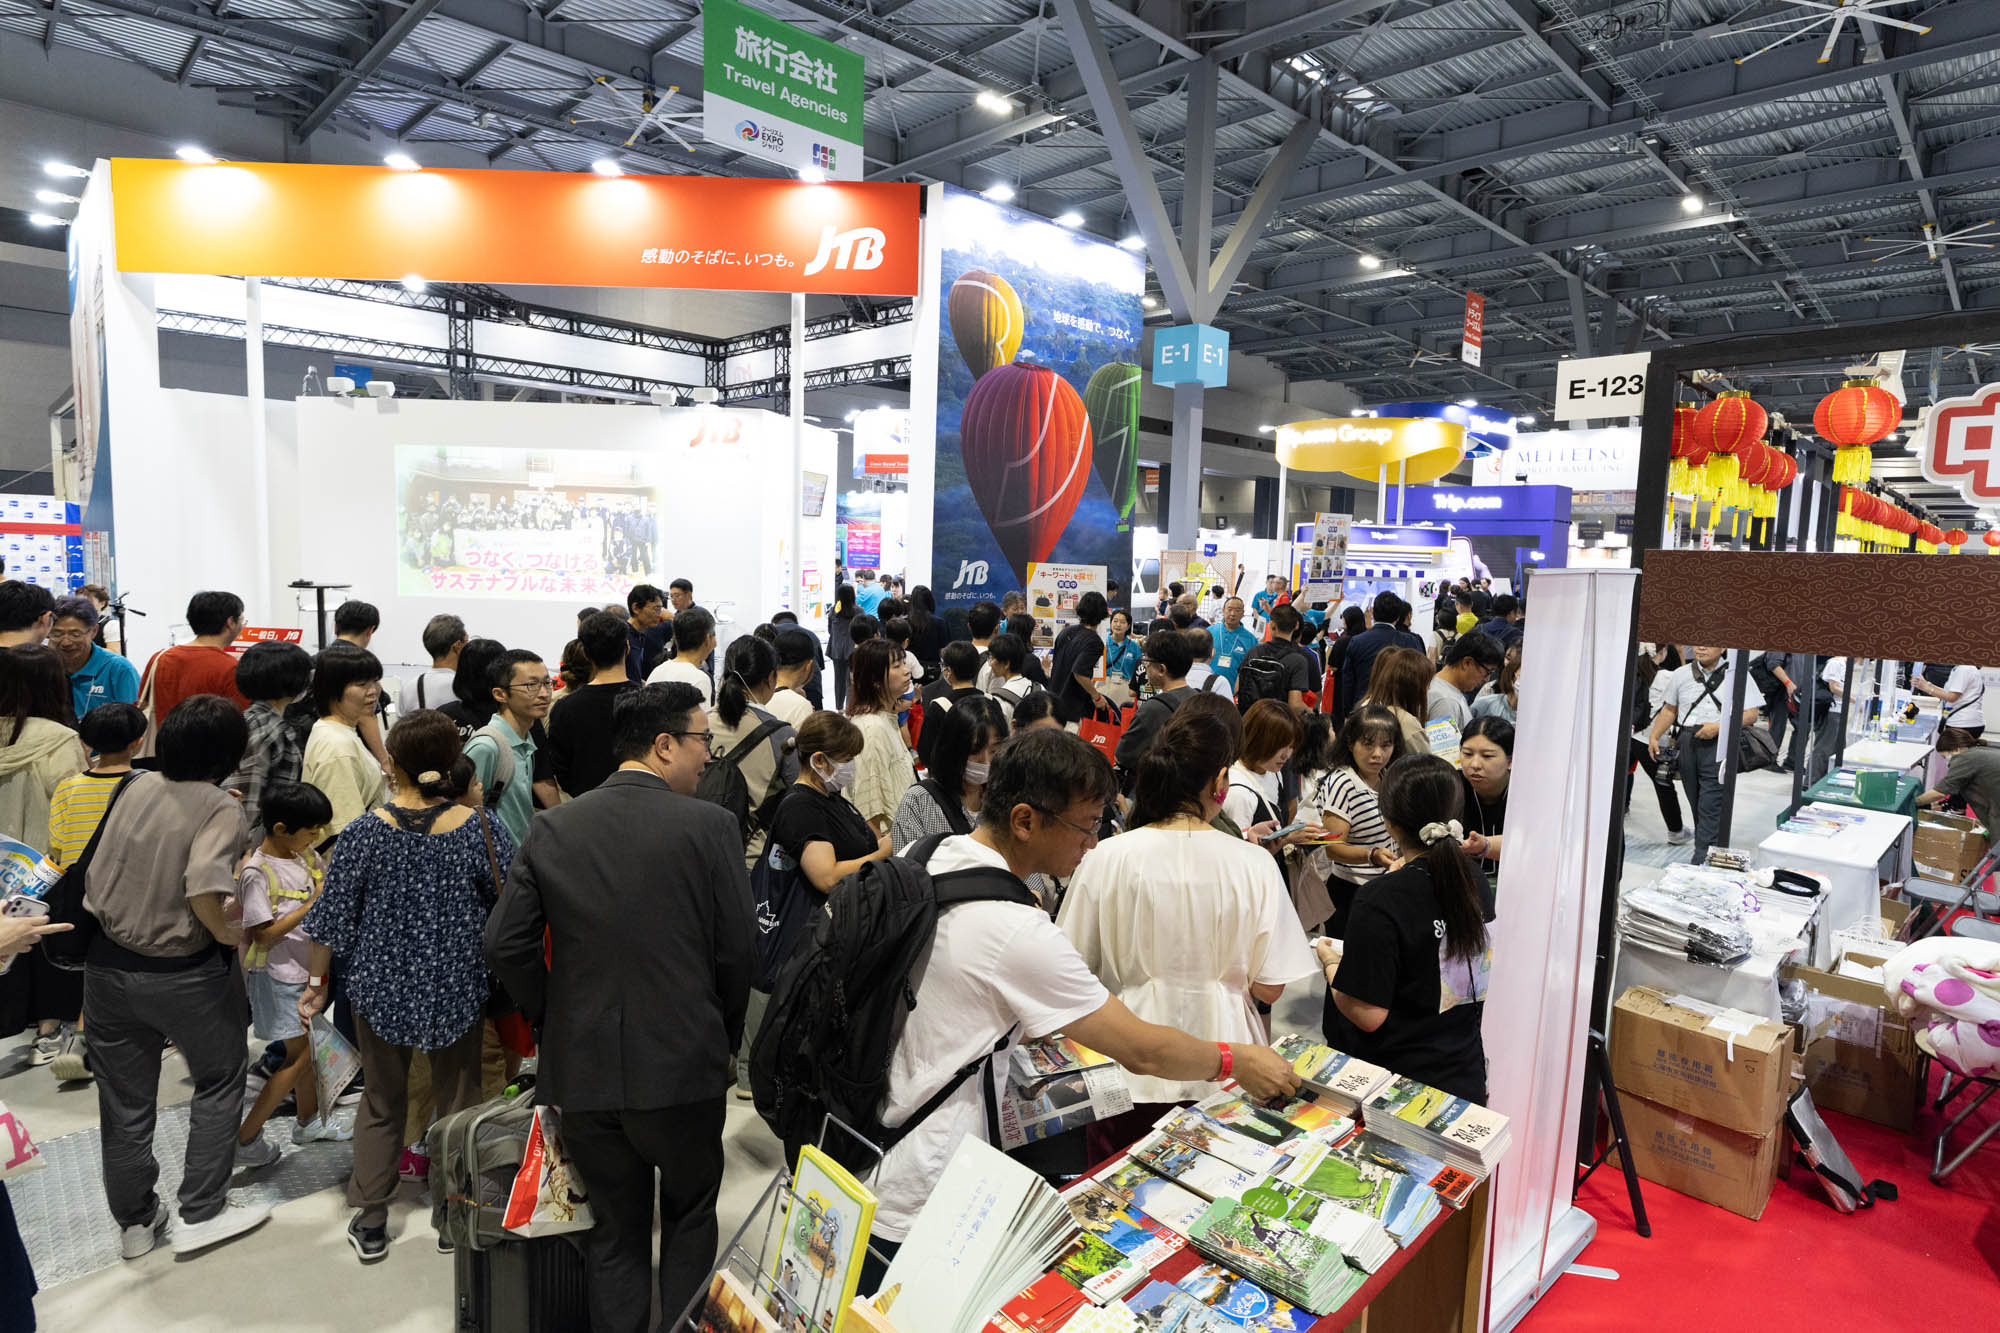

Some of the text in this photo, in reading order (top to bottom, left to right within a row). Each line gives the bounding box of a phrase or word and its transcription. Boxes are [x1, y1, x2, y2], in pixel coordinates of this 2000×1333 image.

[735, 25, 838, 95] 旅行会社
[722, 63, 848, 124] Travel Agencies
[761, 132, 784, 146] EXPO
[762, 142, 784, 153] ジャパン
[640, 247, 795, 268] 感動のそばに、いつも。
[803, 225, 886, 277] JTB
[1053, 310, 1135, 343] 地球を感動で、つなぐ。
[1161, 343, 1190, 365] E-1
[1203, 343, 1223, 367] E-1
[1568, 374, 1644, 400] E-123
[1338, 423, 1392, 446] Group
[1432, 493, 1503, 512] Trip.com
[952, 559, 990, 590] JTB
[945, 592, 997, 601] 感動のそばに、いつも。
[1090, 734, 1107, 744] JTB
